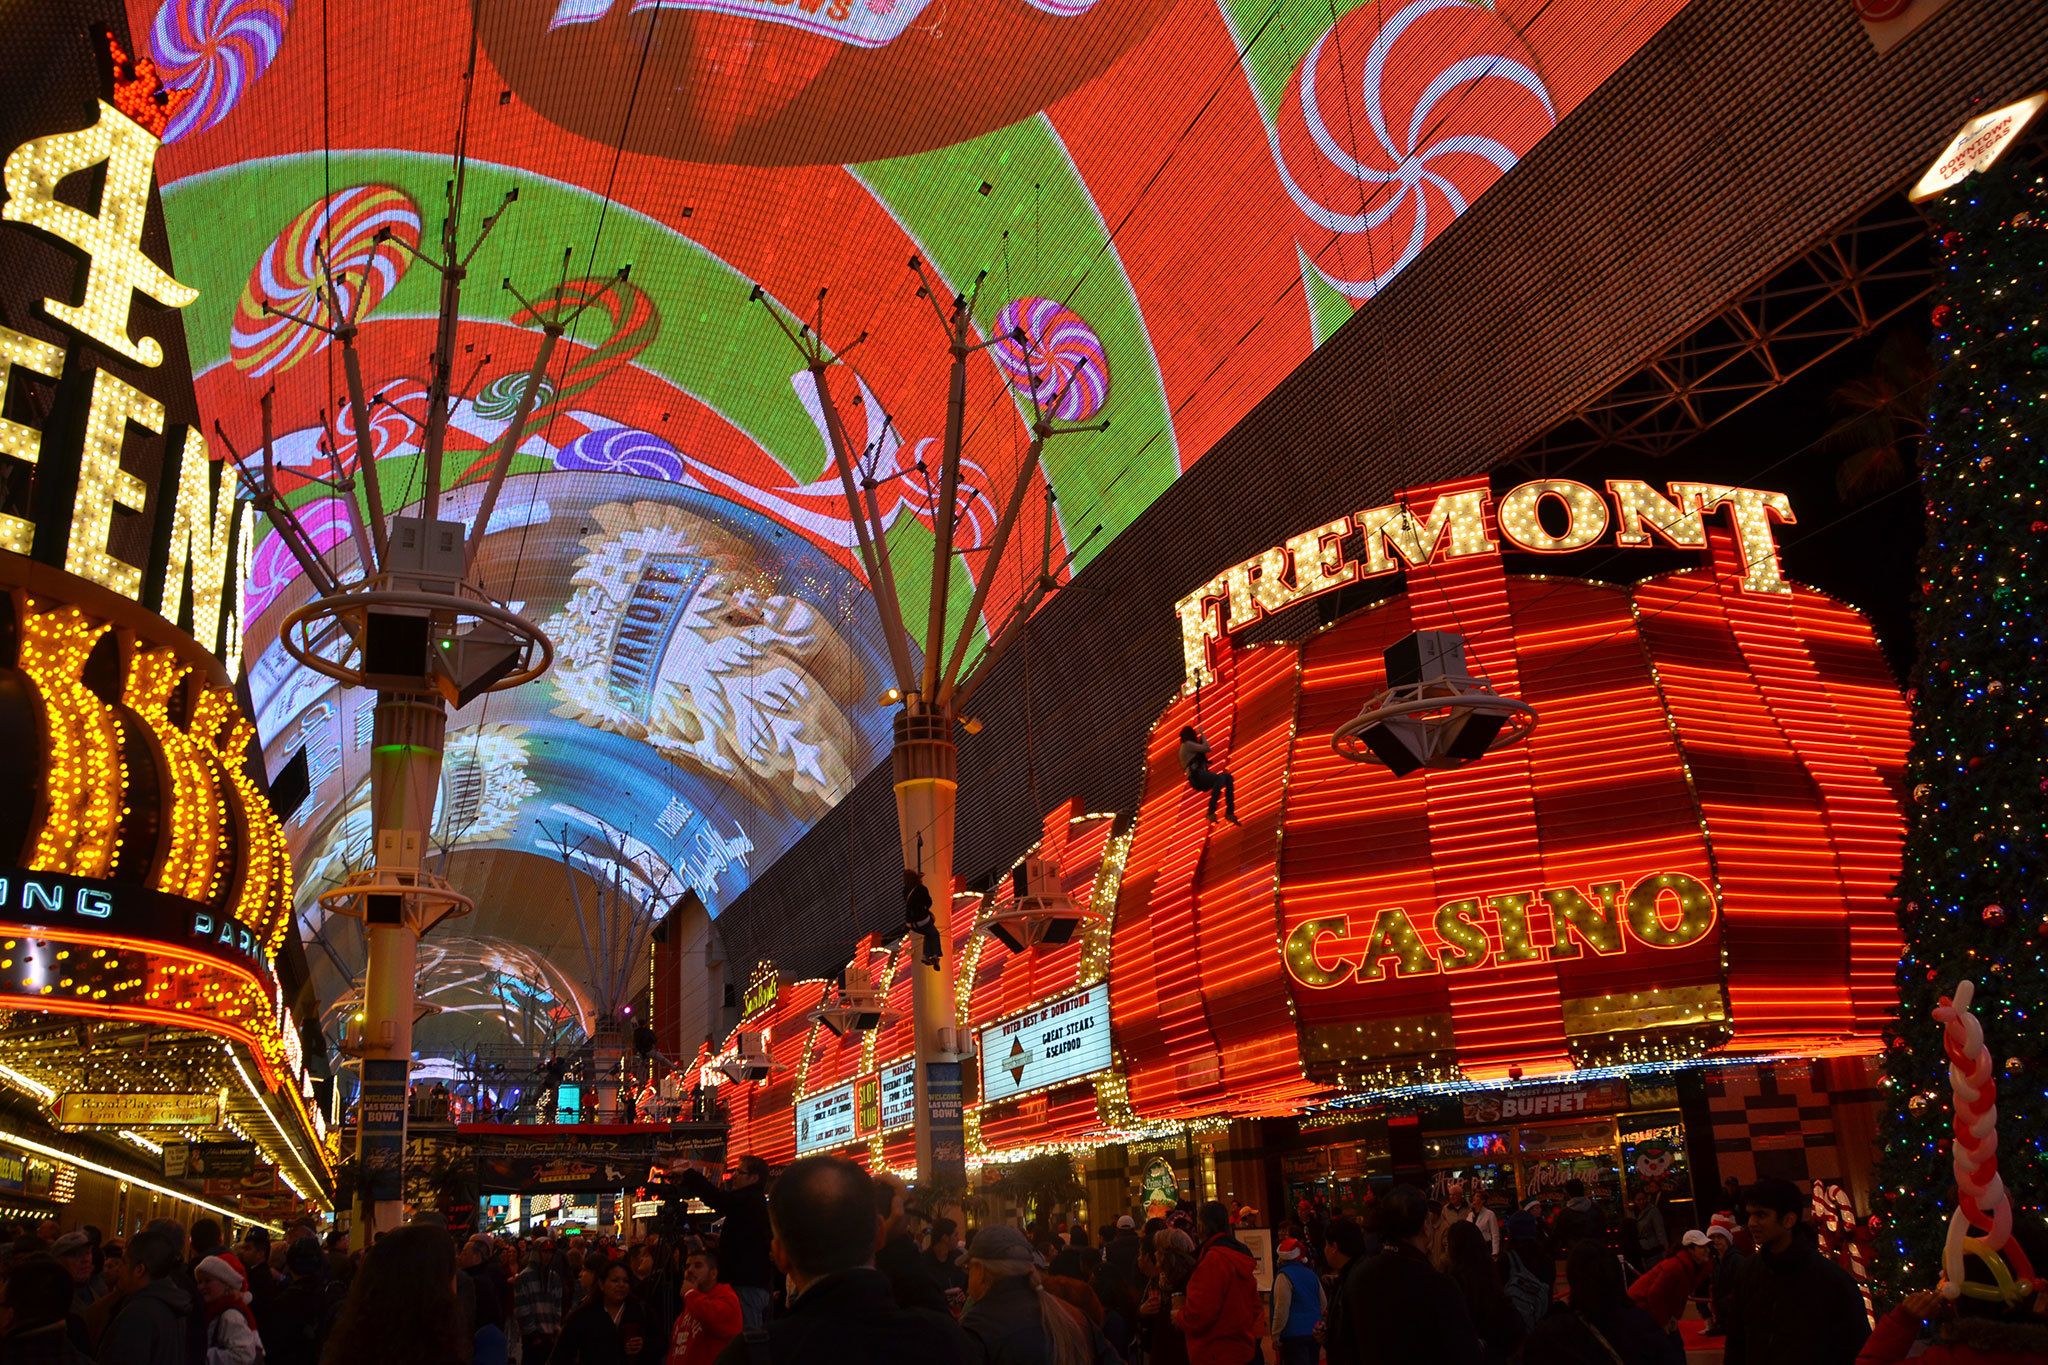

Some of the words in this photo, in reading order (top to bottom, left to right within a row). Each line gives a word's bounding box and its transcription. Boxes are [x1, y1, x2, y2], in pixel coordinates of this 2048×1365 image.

[1940, 116, 2012, 174] DOWNTOWN
[1944, 160, 1966, 180] LAS
[1969, 127, 2010, 160] VEGAS
[1175, 478, 1798, 698] FREMONT
[609, 566, 688, 712] SMIRNOFF
[657, 795, 694, 835] CHOOSE
[1284, 871, 1717, 989] CASINO
[1002, 1020, 1021, 1036] VOTED
[1023, 1014, 1038, 1029] BEST
[1041, 1008, 1048, 1021] OF
[1051, 992, 1090, 1018] DOWNTOWN
[1042, 1027, 1064, 1045] GREAT
[1066, 1016, 1095, 1036] STEAKS
[365, 1094, 403, 1103] WELCOME
[859, 1081, 876, 1104] SLOT
[928, 1093, 961, 1101] WELCOME
[1507, 1089, 1541, 1098] BIGGEST
[1542, 1086, 1561, 1095] AND
[1563, 1084, 1582, 1093] BEST
[81, 1098, 120, 1110] Royal
[122, 1098, 171, 1111] Players
[117, 1110, 144, 1119] Cash
[364, 1103, 379, 1111] LAS
[379, 1103, 404, 1111] VEGAS
[928, 1101, 941, 1109] LAS
[932, 1109, 959, 1118] BOWL
[1502, 1092, 1587, 1118] BUFFET
[368, 1112, 399, 1122] BOWL
[859, 1106, 877, 1128] CLUB
[834, 1125, 851, 1137] SPECIALS
